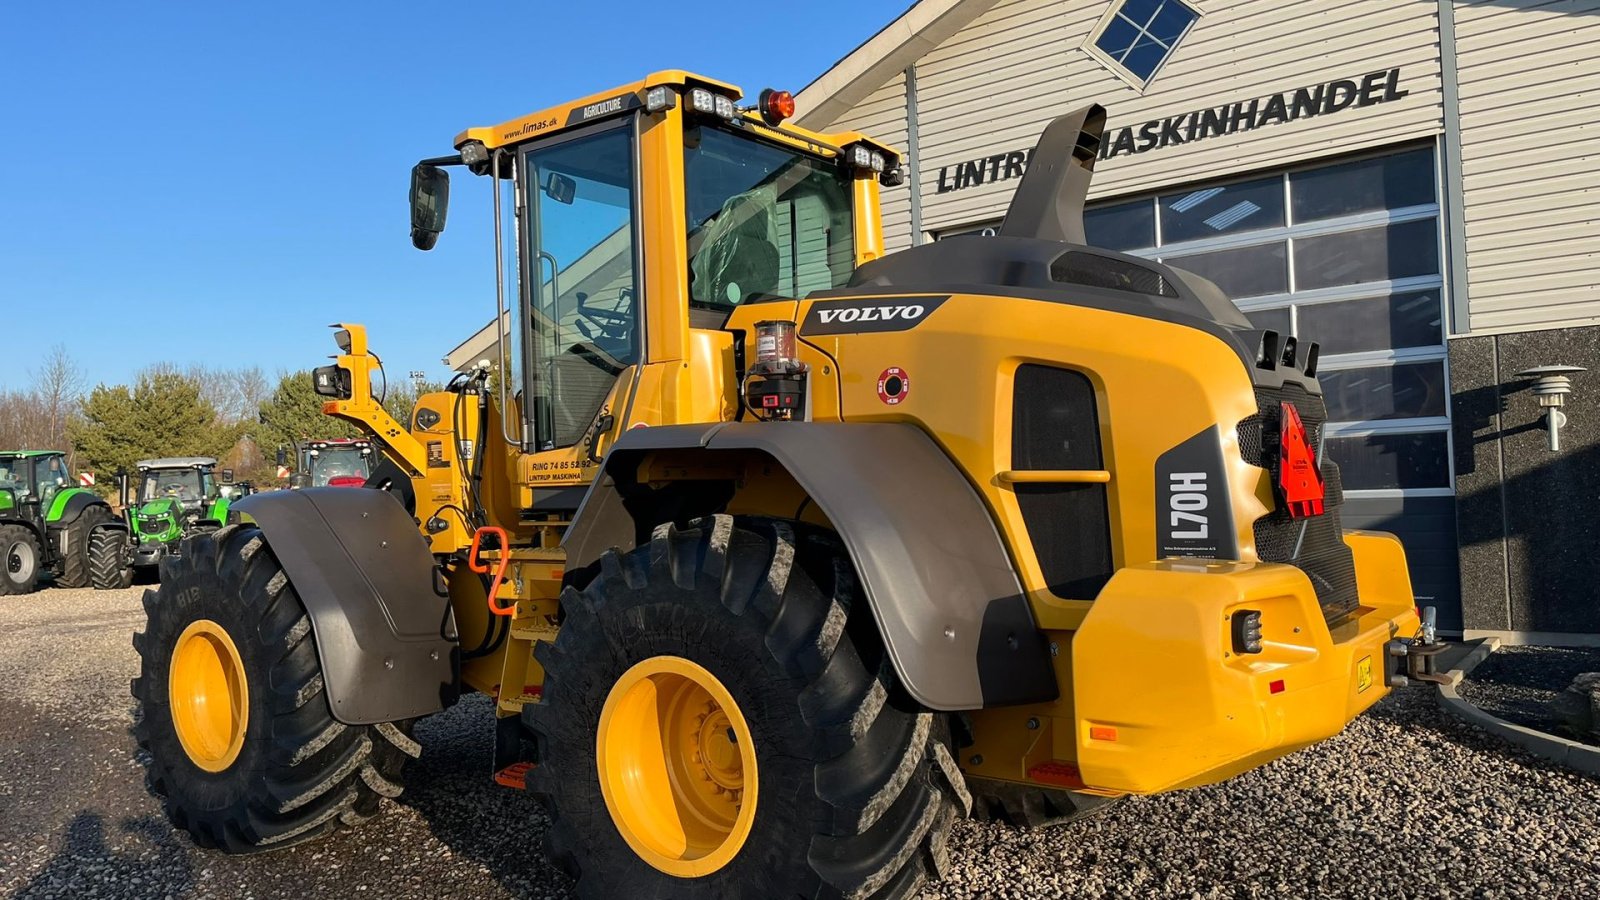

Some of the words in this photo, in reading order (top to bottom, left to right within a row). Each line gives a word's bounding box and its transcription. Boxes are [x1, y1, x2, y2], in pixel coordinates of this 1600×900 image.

[583, 98, 621, 118] AGRICULTURE
[504, 117, 557, 139] www.limas.dk
[817, 305, 925, 324] VOLVO
[532, 463, 549, 471] RING
[550, 462, 558, 470] 74
[581, 460, 591, 468] 92
[1170, 472, 1208, 539] L70H
